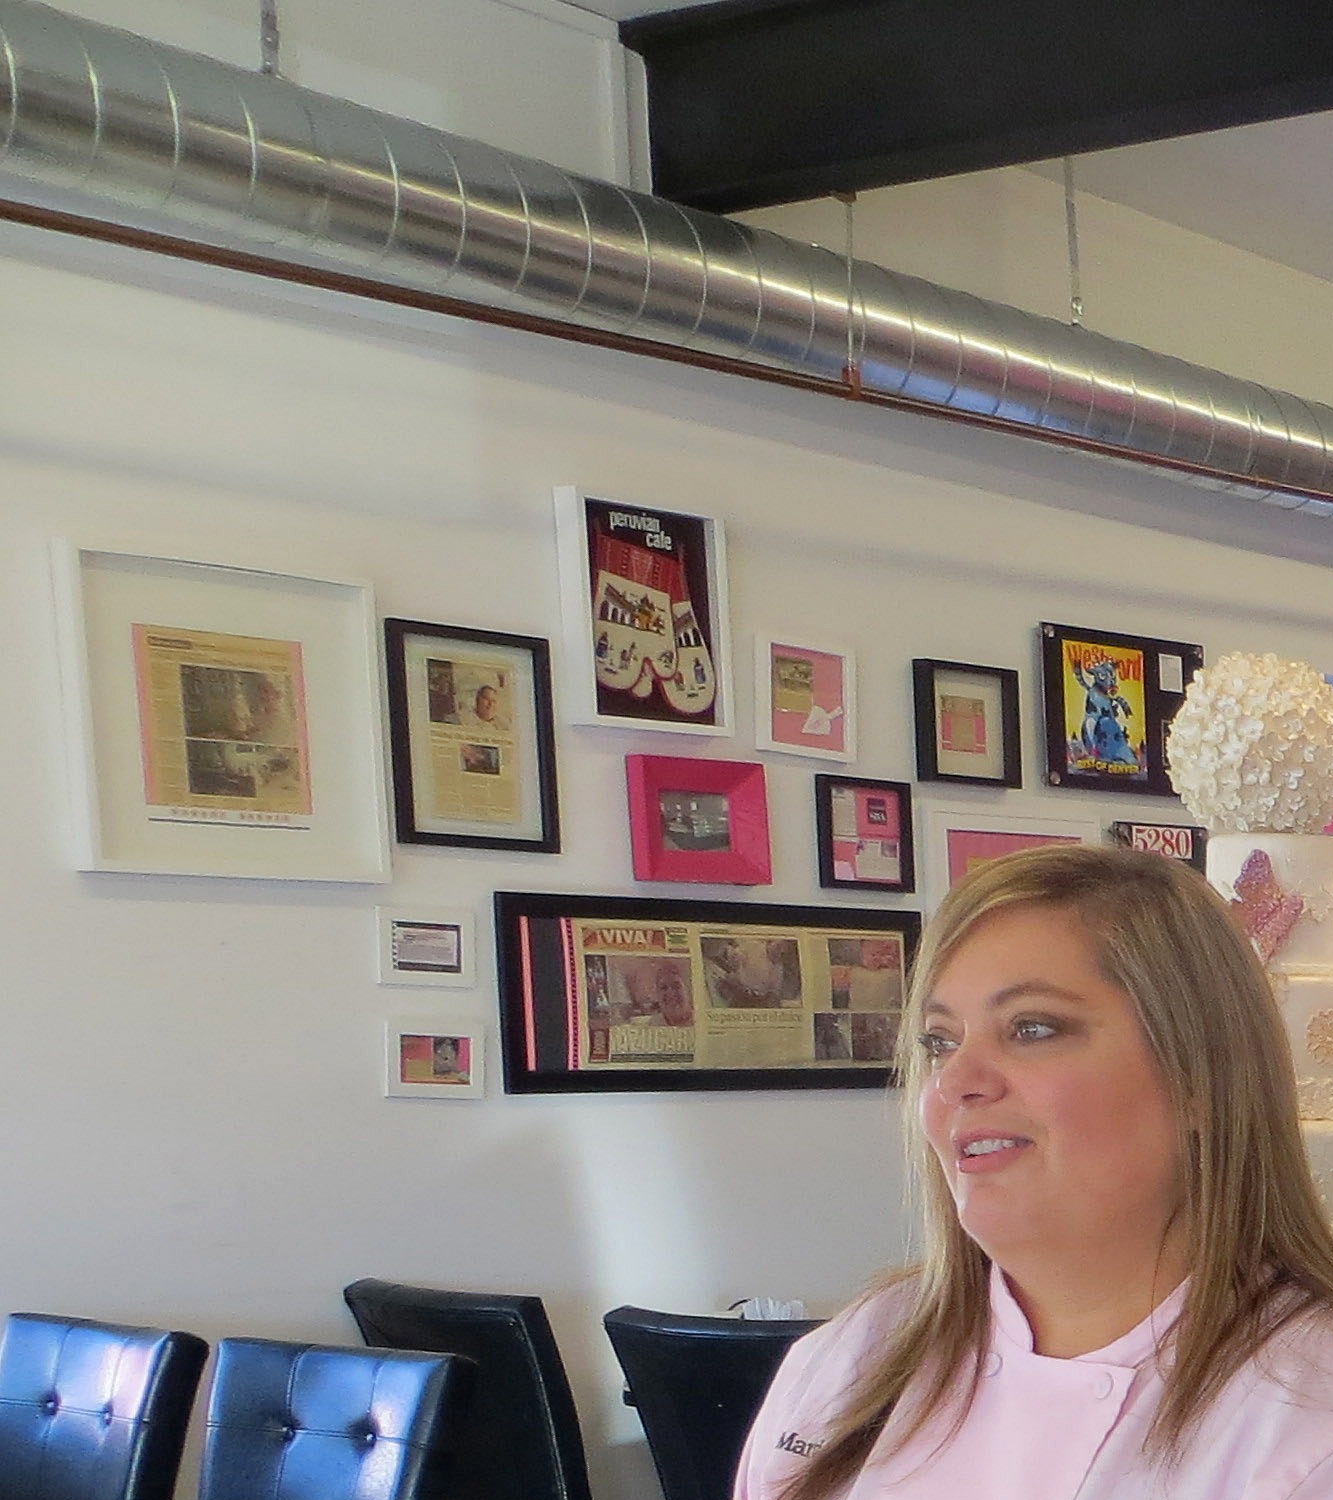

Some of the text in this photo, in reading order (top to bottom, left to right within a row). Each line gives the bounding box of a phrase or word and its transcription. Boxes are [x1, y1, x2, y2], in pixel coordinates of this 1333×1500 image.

[608, 510, 661, 532] peruvian
[645, 530, 673, 551] cafe
[1066, 644, 1144, 681] Westord
[1107, 763, 1140, 774] DENVER
[1133, 826, 1192, 859] 5280
